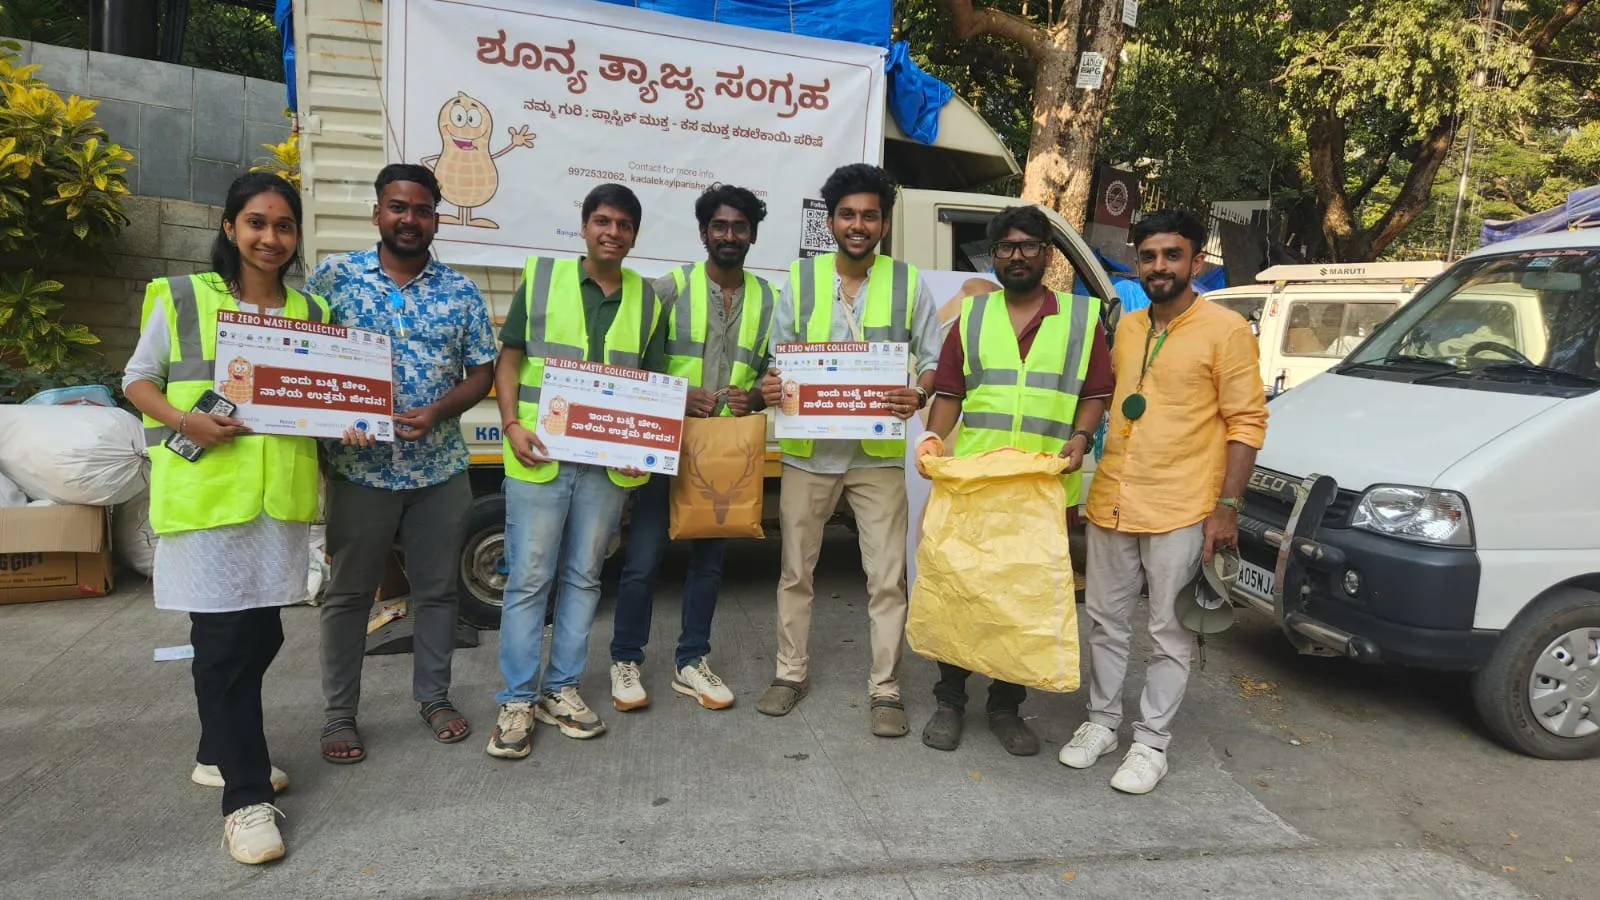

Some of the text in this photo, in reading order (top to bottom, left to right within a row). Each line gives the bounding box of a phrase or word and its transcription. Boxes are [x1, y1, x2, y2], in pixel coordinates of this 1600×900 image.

[476, 29, 830, 118] ಶೂನ್ಯ ತ್ಯಾಜ್ಯ ಸಂಗ್ರಹ
[524, 99, 556, 119] ನಮ್ಮ
[558, 102, 583, 117] ಗುರಿ
[639, 114, 670, 132] ಮುಕ್ತ
[680, 118, 698, 132] ಕಸ
[701, 121, 730, 140] ಮುಕ್ತ
[628, 161, 661, 173] Contact
[663, 165, 674, 174] for
[676, 168, 697, 177] more
[218, 311, 347, 338] THE ZERO WASTE COLLECTIVE
[776, 343, 868, 353] THE ZERO WASTE COLLECTIVE
[545, 357, 648, 380] THE ZERO WASTE COLLECTIVE
[280, 375, 312, 386] ಇಂದು
[260, 387, 386, 407] ನಾಳೆಯ ಉತ್ತಮ ಜೀವನ!
[817, 389, 840, 398] ಇಂದು
[588, 412, 614, 423] ಇಂದು
[475, 427, 504, 441] KA
